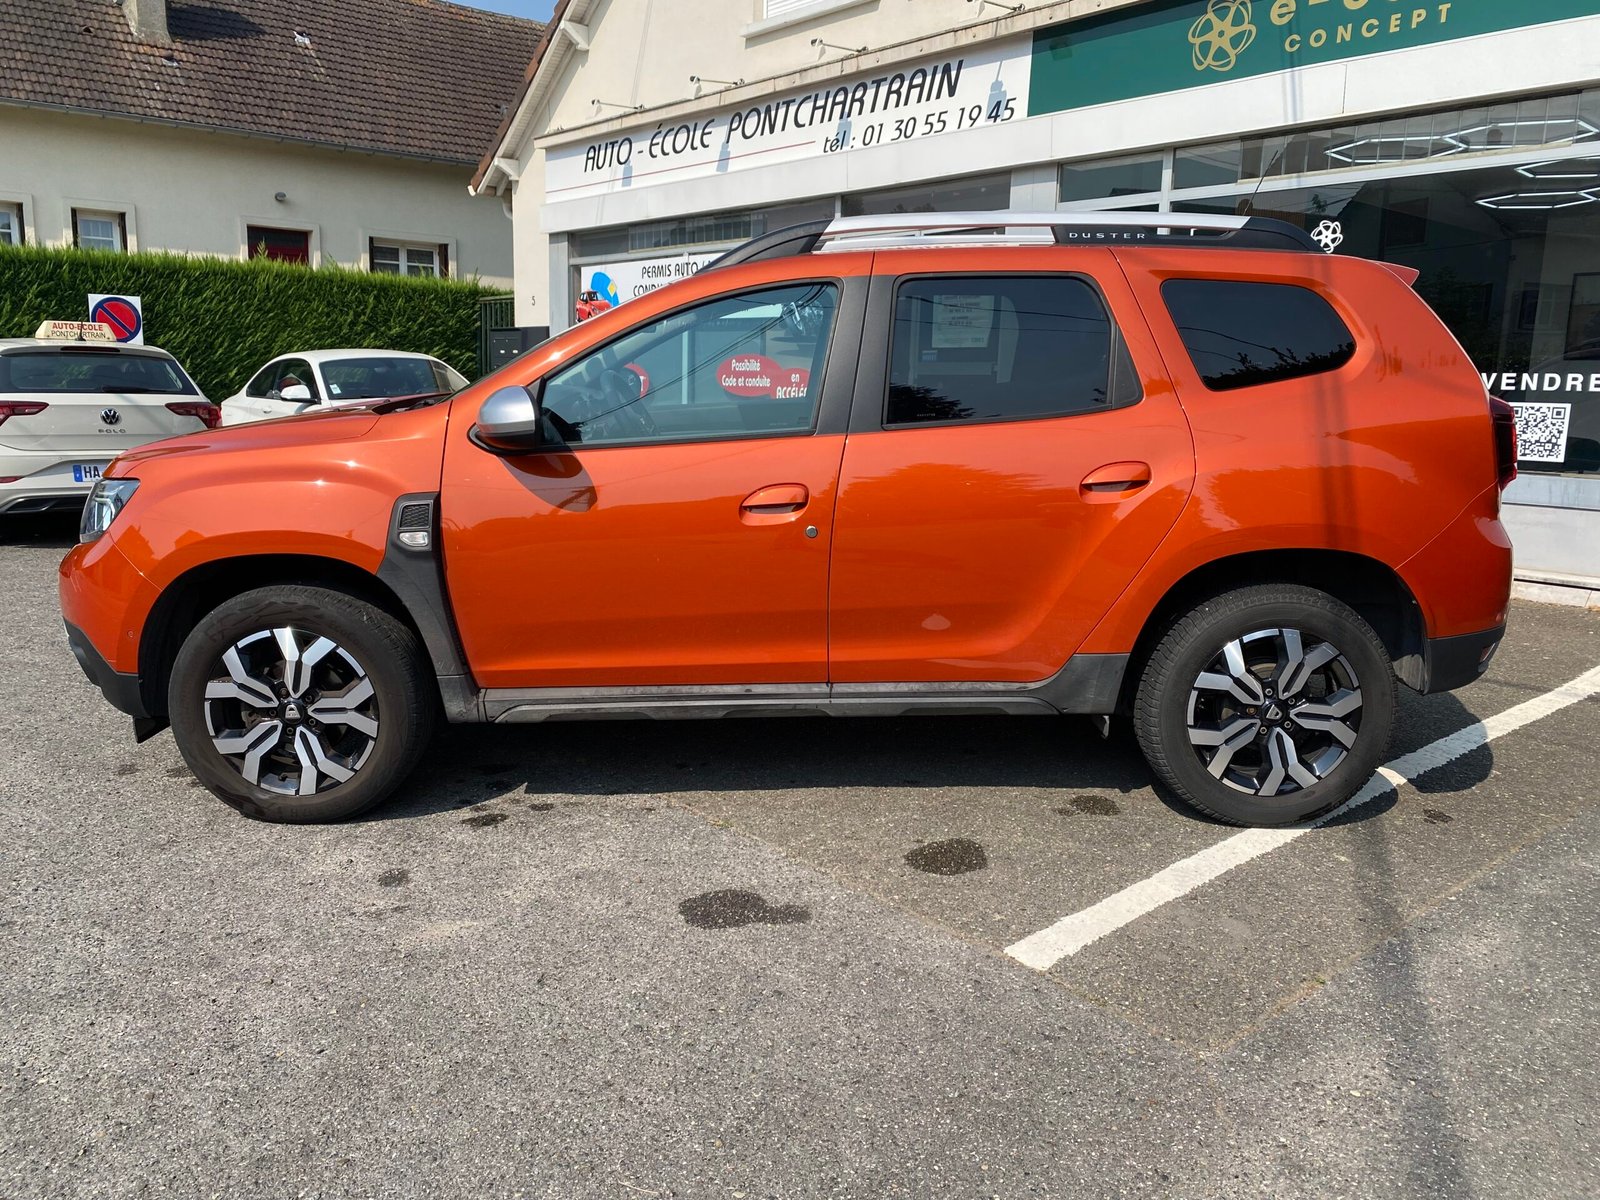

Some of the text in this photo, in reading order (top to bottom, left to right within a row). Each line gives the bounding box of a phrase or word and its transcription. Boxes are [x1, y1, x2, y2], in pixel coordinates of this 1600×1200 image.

[1284, 3, 1452, 52] CONCEPT
[584, 137, 633, 173] AUTO
[649, 118, 715, 158] ÉCOLE
[726, 59, 964, 144] PONTCHARTRAIN
[823, 130, 845, 153] tél
[862, 123, 885, 147] 01
[891, 116, 917, 142] 30
[921, 110, 949, 136] 55
[957, 105, 983, 130] 19
[987, 97, 1018, 123] 45
[641, 264, 672, 279] PERMIS
[674, 261, 699, 277] AUTO
[531, 295, 536, 306] 5
[52, 322, 104, 331] AUTO-ECOLE
[731, 359, 761, 371] Possibilité
[721, 374, 771, 387] Code et conduite
[791, 374, 800, 382] en
[1481, 372, 1600, 392] VENDRE
